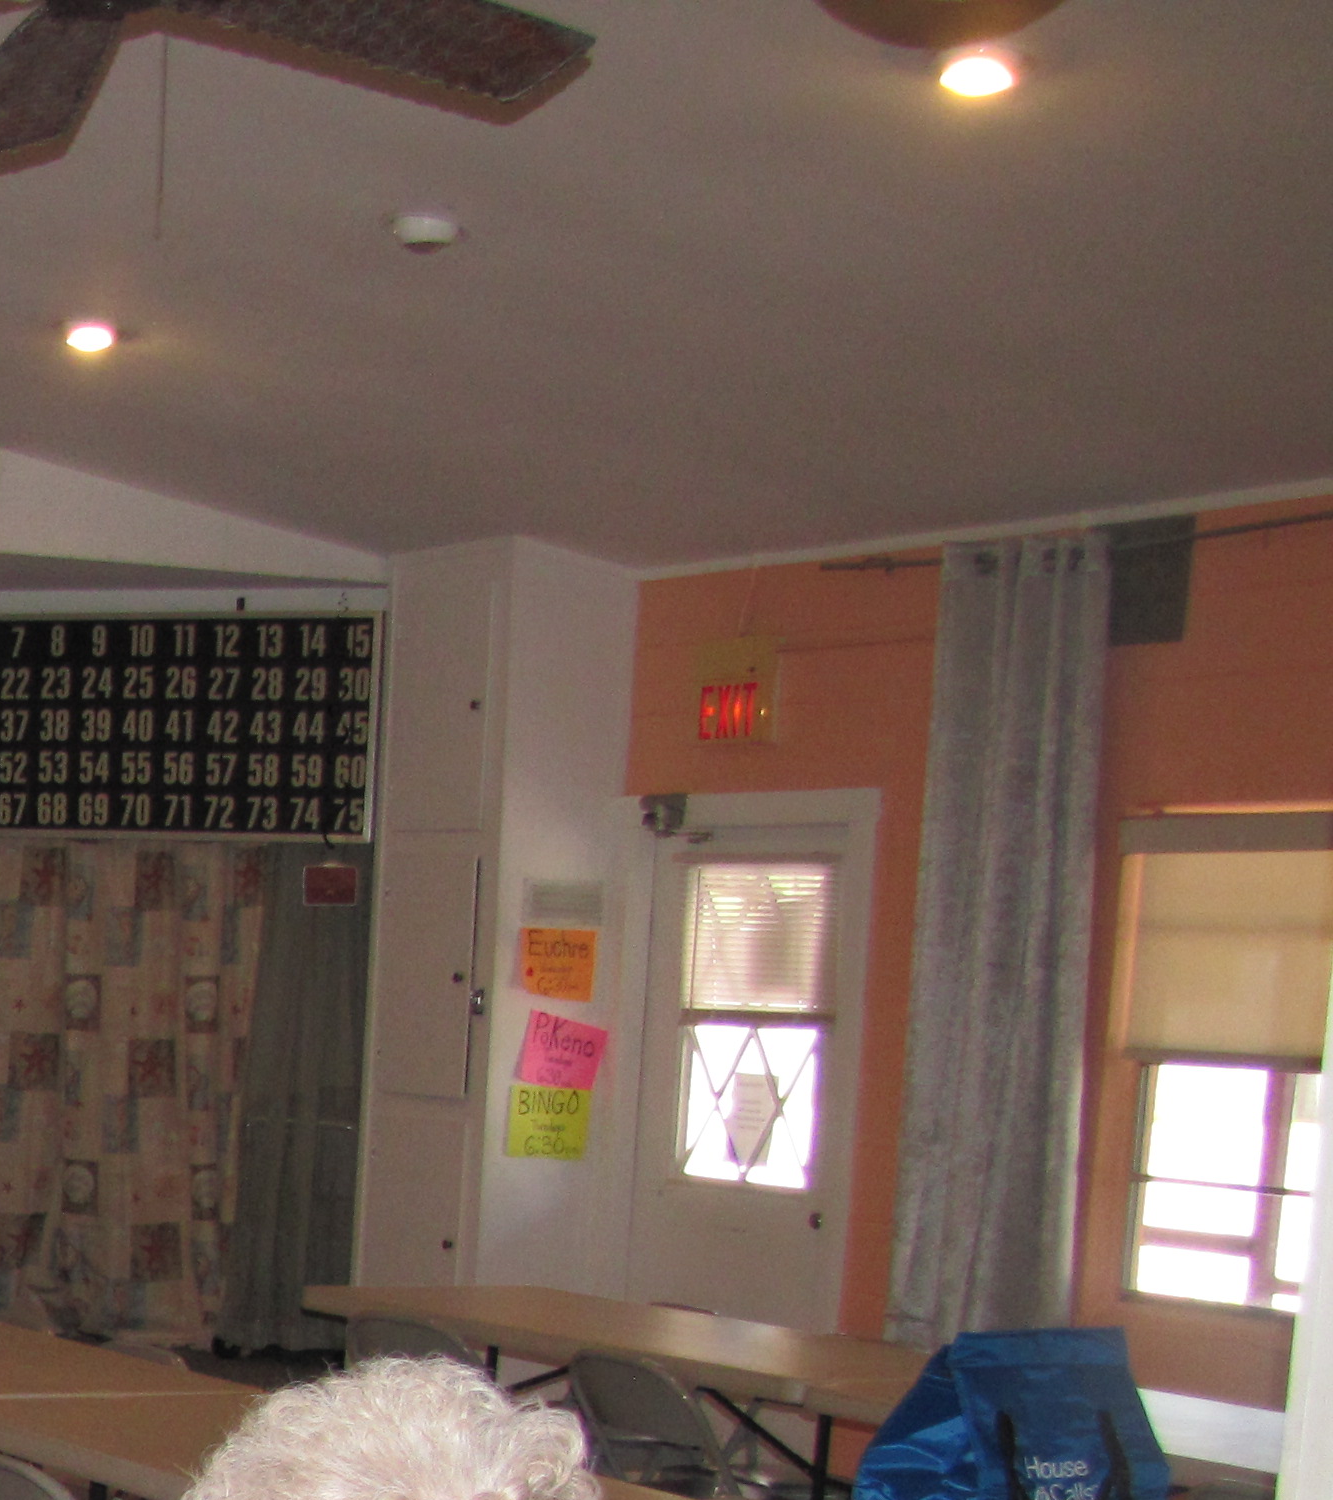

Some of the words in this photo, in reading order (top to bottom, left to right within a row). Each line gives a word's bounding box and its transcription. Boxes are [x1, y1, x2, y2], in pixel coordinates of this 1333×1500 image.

[12, 626, 25, 658] 7
[51, 624, 65, 657] 8
[92, 625, 107, 657] 9
[130, 624, 155, 656] 10
[174, 624, 196, 656] 11
[215, 624, 240, 657] 12
[258, 624, 283, 657] 13
[301, 624, 326, 656] 14
[347, 624, 370, 657] 15
[1, 667, 30, 700] 22
[41, 666, 71, 699] 23
[82, 667, 112, 698] 24
[124, 666, 154, 698] 25
[166, 666, 197, 699] 26
[209, 667, 240, 700] 27
[252, 667, 283, 700] 28
[295, 667, 327, 700] 29
[339, 667, 369, 701] 30
[0, 709, 29, 741] 37
[40, 709, 69, 741] 38
[81, 709, 111, 741] 39
[123, 709, 153, 741] 40
[165, 710, 193, 741] 41
[207, 710, 239, 743] 42
[250, 710, 282, 743] 43
[293, 711, 325, 743] 44
[337, 711, 367, 744] 45
[698, 682, 757, 740] EXIT
[0, 752, 27, 783] 52
[39, 750, 68, 783] 53
[80, 751, 109, 783] 54
[122, 751, 151, 784] 55
[164, 752, 194, 784] 56
[206, 753, 237, 785] 57
[248, 753, 279, 786] 58
[292, 754, 323, 787] 59
[335, 755, 364, 788] 60
[38, 795, 67, 826] 68
[79, 796, 109, 827] 69
[121, 796, 151, 827] 70
[165, 797, 191, 828] 71
[205, 797, 235, 829] 72
[248, 798, 278, 829] 73
[291, 798, 320, 830] 74
[334, 799, 362, 830] 75
[518, 1090, 580, 1115] BINGO
[1024, 1456, 1089, 1478] House
